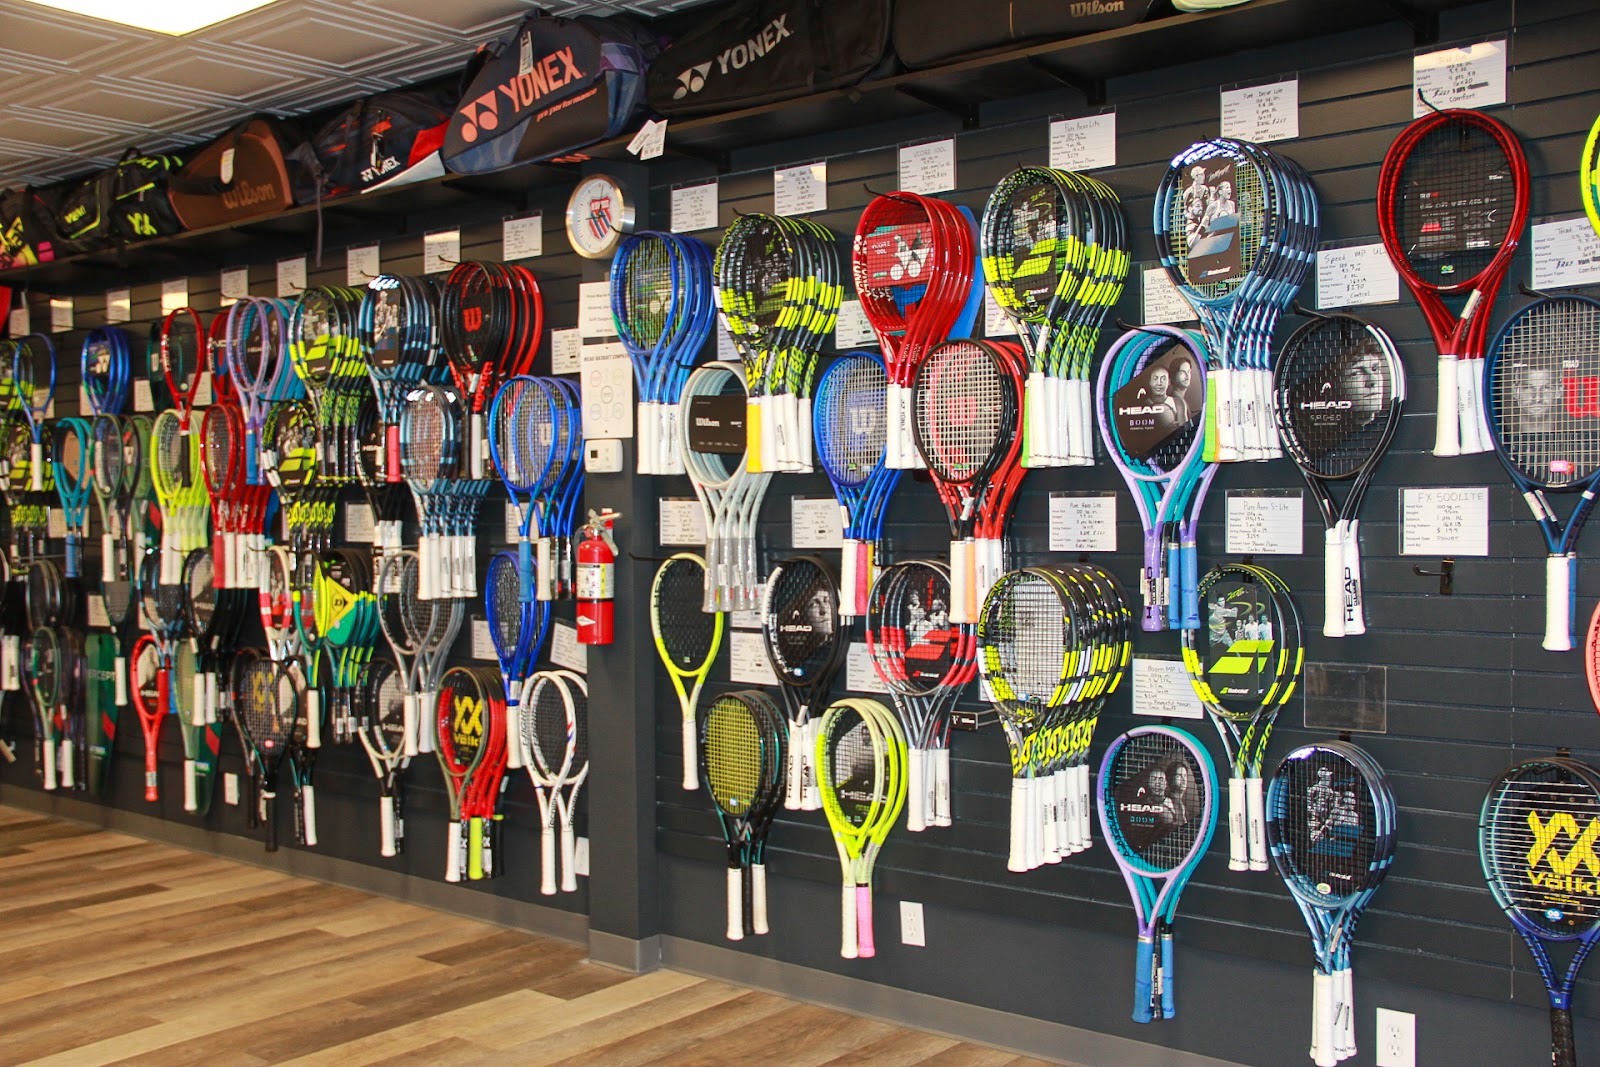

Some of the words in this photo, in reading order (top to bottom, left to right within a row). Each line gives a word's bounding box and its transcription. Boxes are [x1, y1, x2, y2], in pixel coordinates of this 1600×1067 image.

[1070, 1, 1124, 17] Wilson
[716, 13, 792, 75] YONEX
[497, 46, 583, 113] YONEX
[536, 109, 549, 122] pro
[1324, 254, 1345, 264] Speed
[1562, 360, 1580, 368] TRIAD
[1300, 401, 1352, 410] HEAD
[1118, 406, 1165, 416] HEAD
[696, 417, 720, 427] Wilson
[1418, 493, 1431, 502] FX
[1437, 492, 1483, 502] 500LITE
[1344, 566, 1354, 622] HEAD
[87, 670, 116, 681] ERCEPT
[454, 731, 481, 747] Völk
[1120, 803, 1164, 813] HEAD
